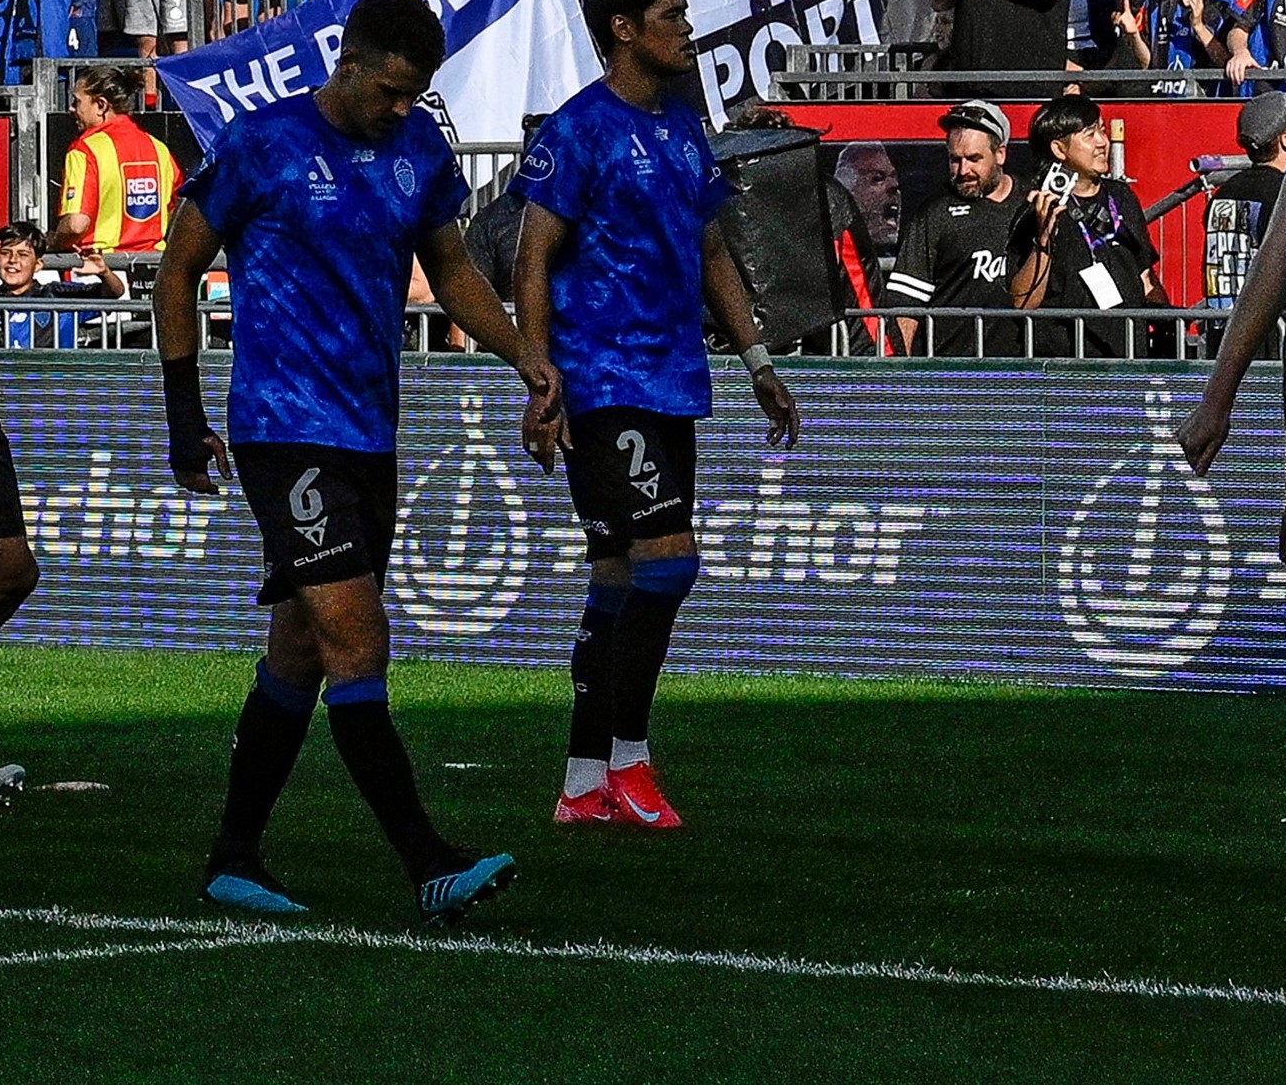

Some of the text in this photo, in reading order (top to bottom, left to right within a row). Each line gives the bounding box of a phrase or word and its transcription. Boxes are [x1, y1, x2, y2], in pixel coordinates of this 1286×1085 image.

[69, 29, 78, 48] 4
[187, 45, 311, 121] THE
[126, 179, 157, 195] RED
[127, 195, 157, 207] BADGE
[616, 430, 655, 477] 2
[288, 467, 323, 521] 6
[632, 496, 682, 519] CUPRA
[294, 545, 353, 568] CUPRA
